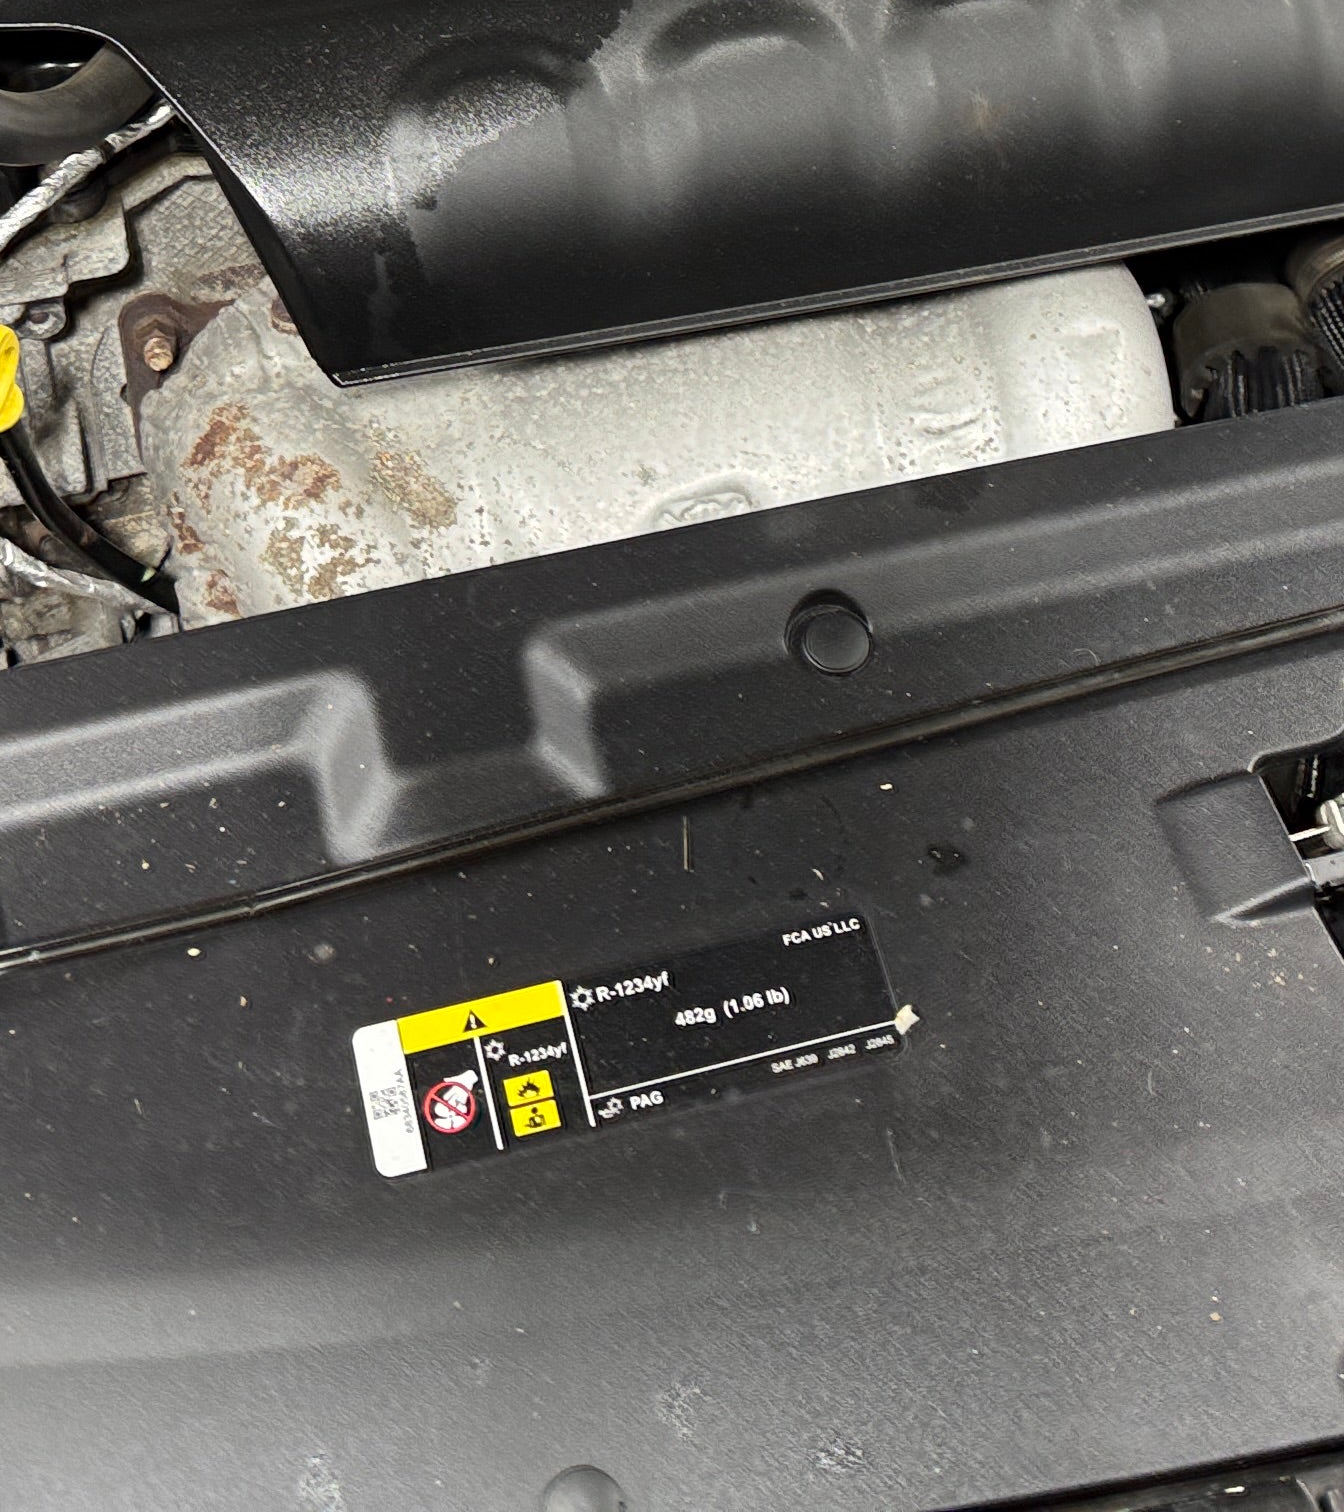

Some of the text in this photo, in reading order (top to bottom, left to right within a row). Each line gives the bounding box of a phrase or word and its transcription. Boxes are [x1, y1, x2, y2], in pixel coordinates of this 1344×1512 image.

[782, 918, 861, 946] FCA US LLC
[595, 970, 670, 1003] R-1234yf
[674, 987, 791, 1028] 482g (1.06 lb)
[508, 1041, 568, 1068] R-1234yf
[629, 1090, 665, 1111] PAG
